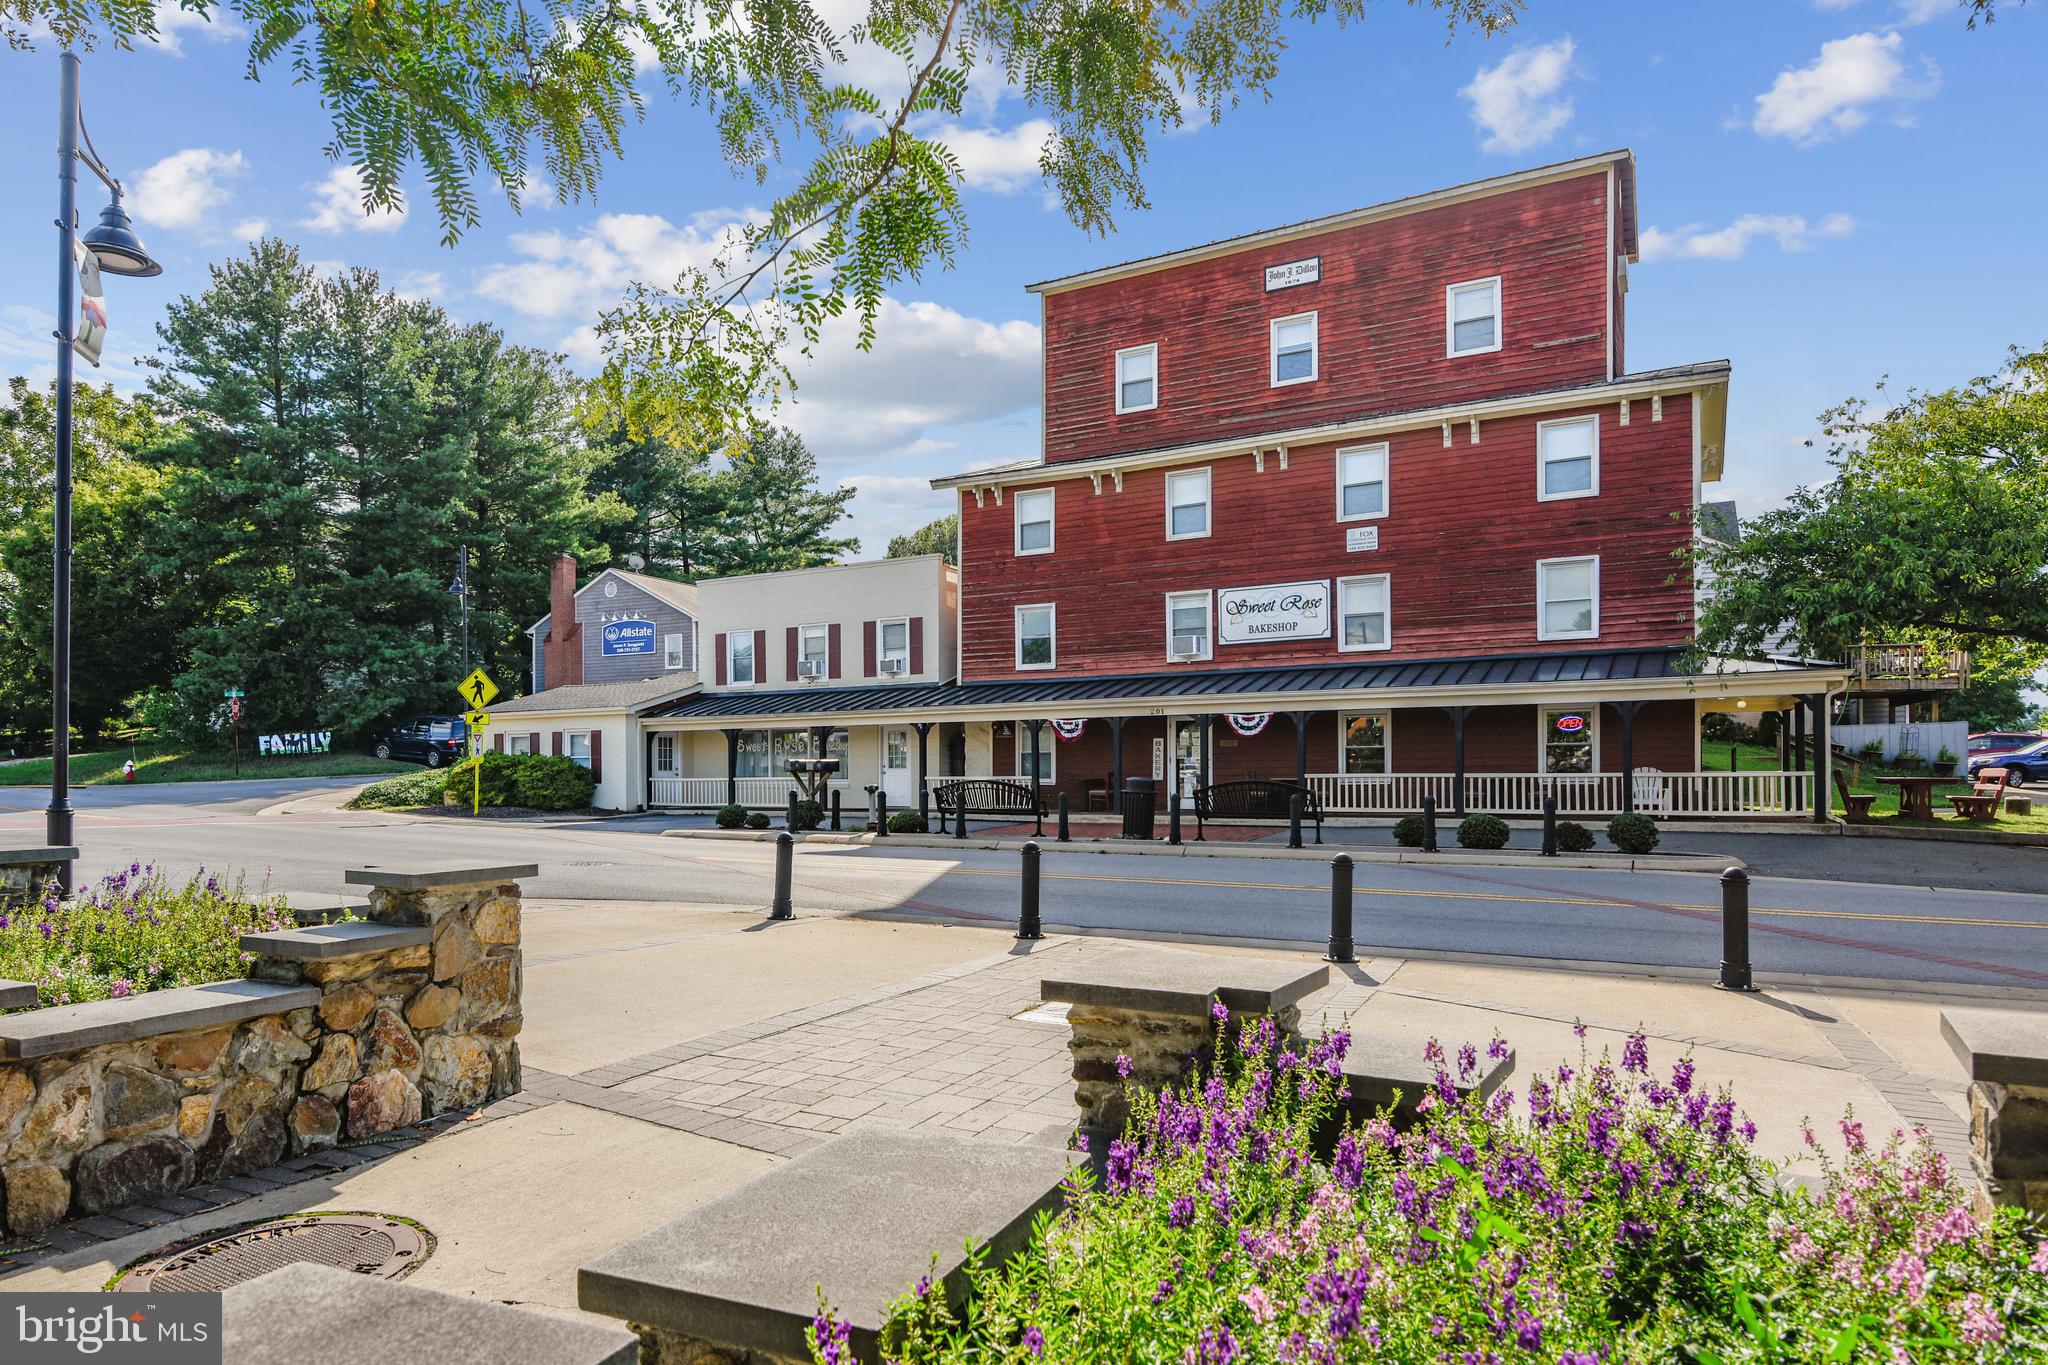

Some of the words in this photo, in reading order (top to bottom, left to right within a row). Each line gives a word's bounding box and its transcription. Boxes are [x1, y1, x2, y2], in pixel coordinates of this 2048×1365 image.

[1268, 270, 1286, 282] John
[1295, 264, 1318, 275] Dillon
[1226, 599, 1276, 615] Sweet
[1280, 595, 1322, 611] Rose
[620, 627, 653, 638] Allstate
[1248, 622, 1298, 634] BAKESHOP
[1557, 718, 1584, 728] OPEN
[258, 731, 332, 756] FAMILY
[737, 739, 768, 752] Sweet
[1154, 740, 1162, 778] BAKERY
